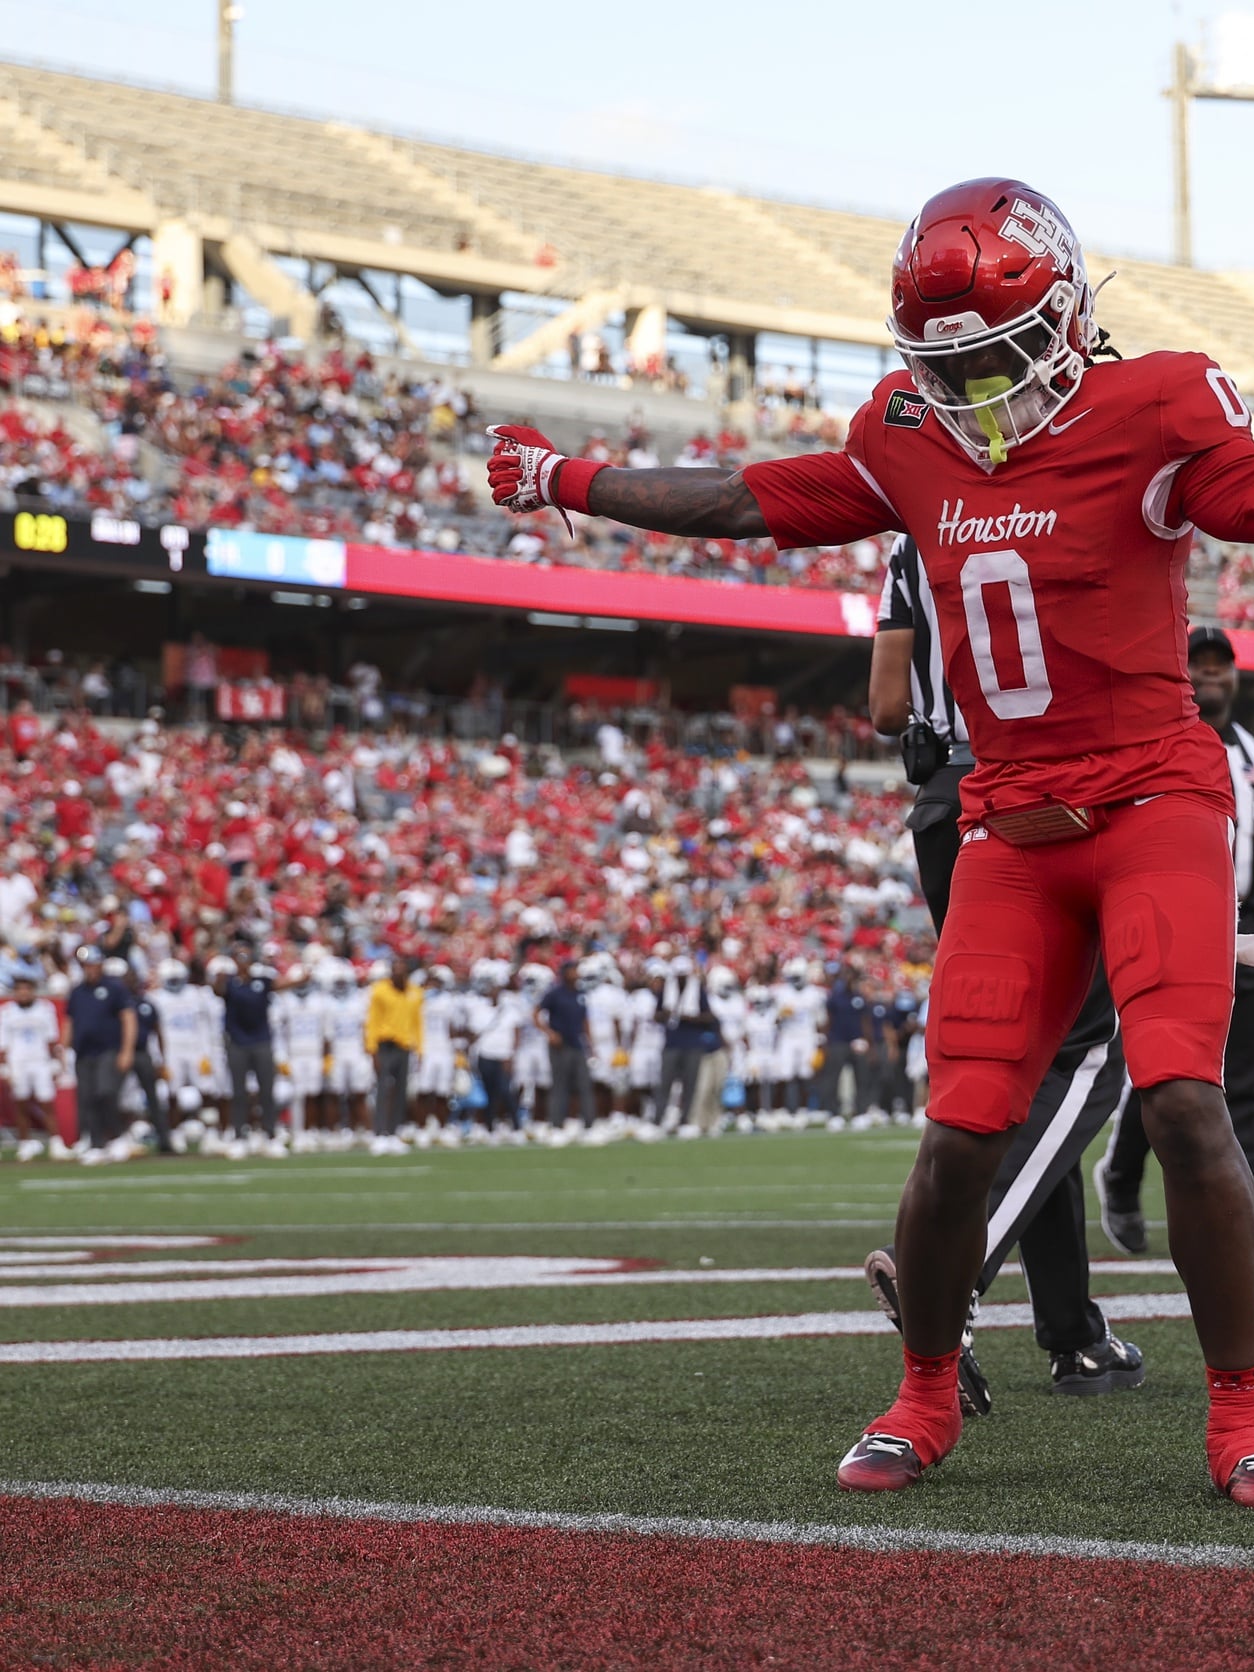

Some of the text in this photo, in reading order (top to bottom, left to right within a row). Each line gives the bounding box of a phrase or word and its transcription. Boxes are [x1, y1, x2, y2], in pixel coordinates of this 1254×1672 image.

[1205, 368, 1250, 427] 0
[937, 498, 1057, 547] Houston
[960, 549, 1053, 720] 0
